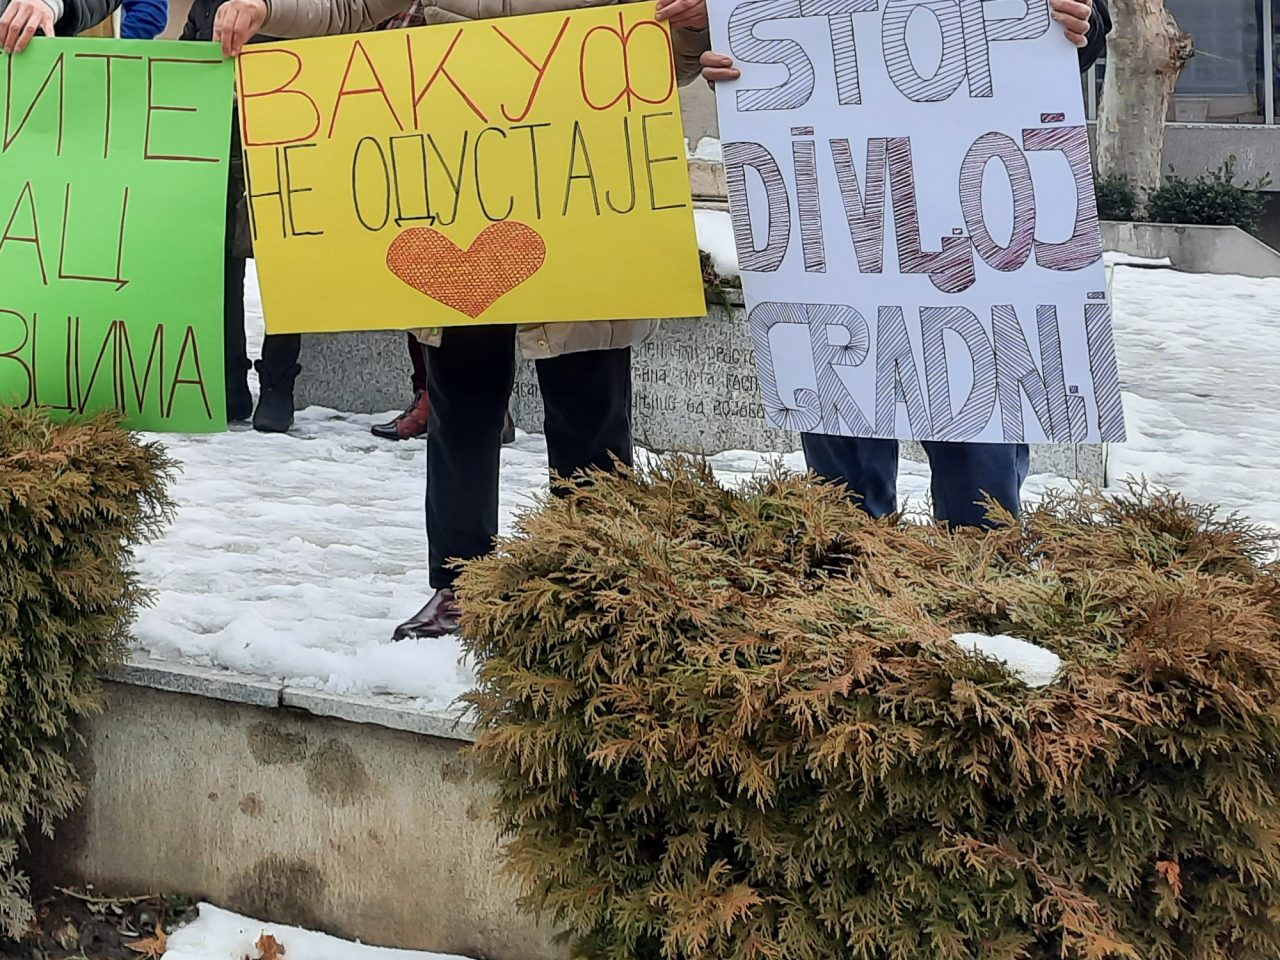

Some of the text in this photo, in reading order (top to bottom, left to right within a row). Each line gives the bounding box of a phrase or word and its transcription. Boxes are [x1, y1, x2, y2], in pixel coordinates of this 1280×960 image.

[238, 11, 675, 147] ВАКУФ
[244, 111, 687, 241] НЕ ОДУСТАЈЕ
